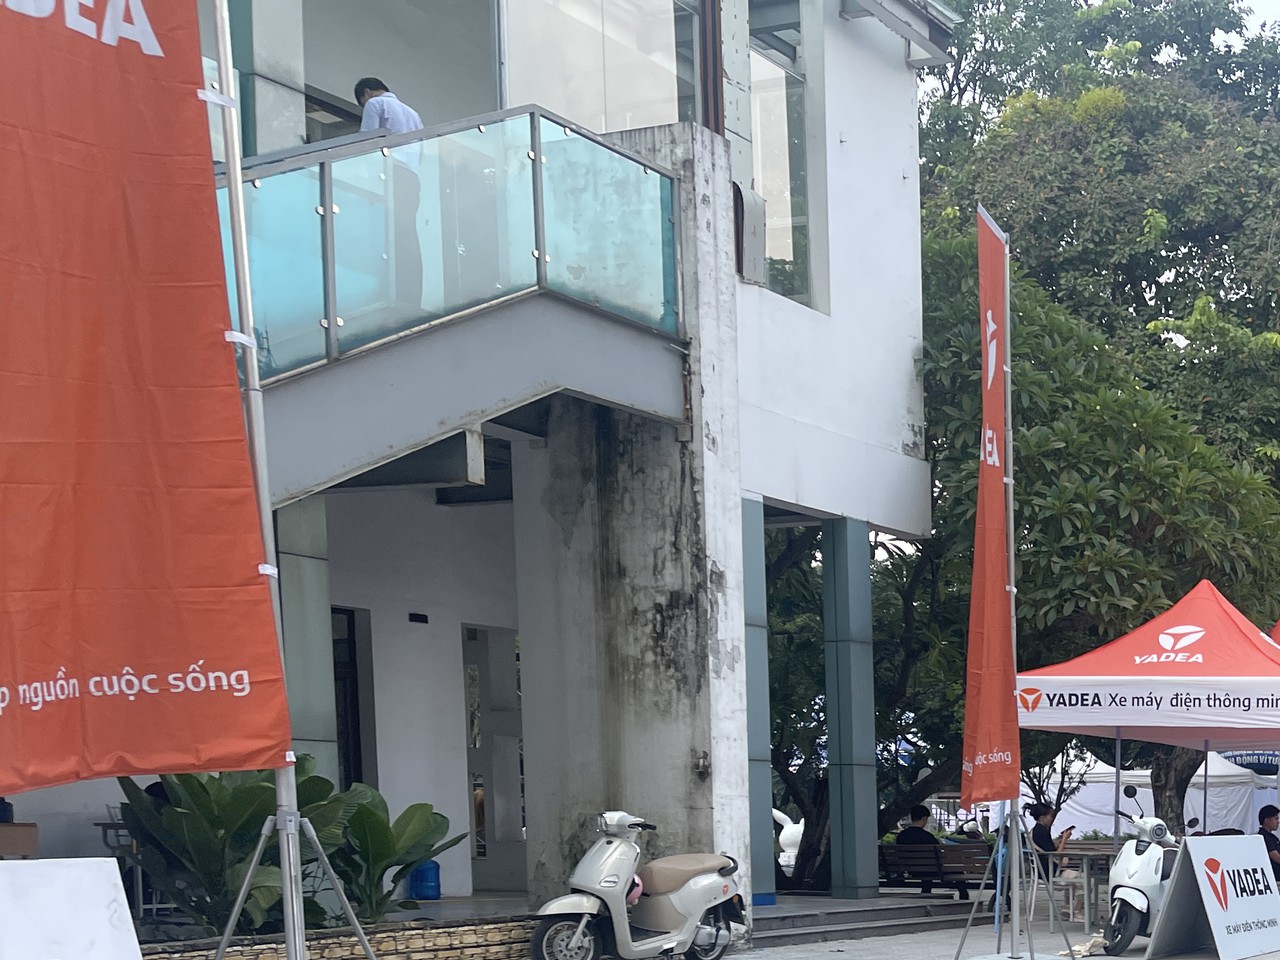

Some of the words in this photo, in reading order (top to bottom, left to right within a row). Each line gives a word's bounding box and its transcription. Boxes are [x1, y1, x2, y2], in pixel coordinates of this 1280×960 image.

[1133, 653, 1204, 664] YADEA
[18, 666, 79, 711] nguồn
[88, 666, 159, 701] cuộc
[167, 659, 251, 696] sống
[1045, 692, 1103, 707] YADEA
[1108, 693, 1127, 707] Xe
[1131, 691, 1163, 711] máy
[1170, 692, 1201, 711] điện
[1206, 693, 1251, 711] thông
[988, 747, 1012, 765] sống
[1226, 867, 1273, 898] YADEA
